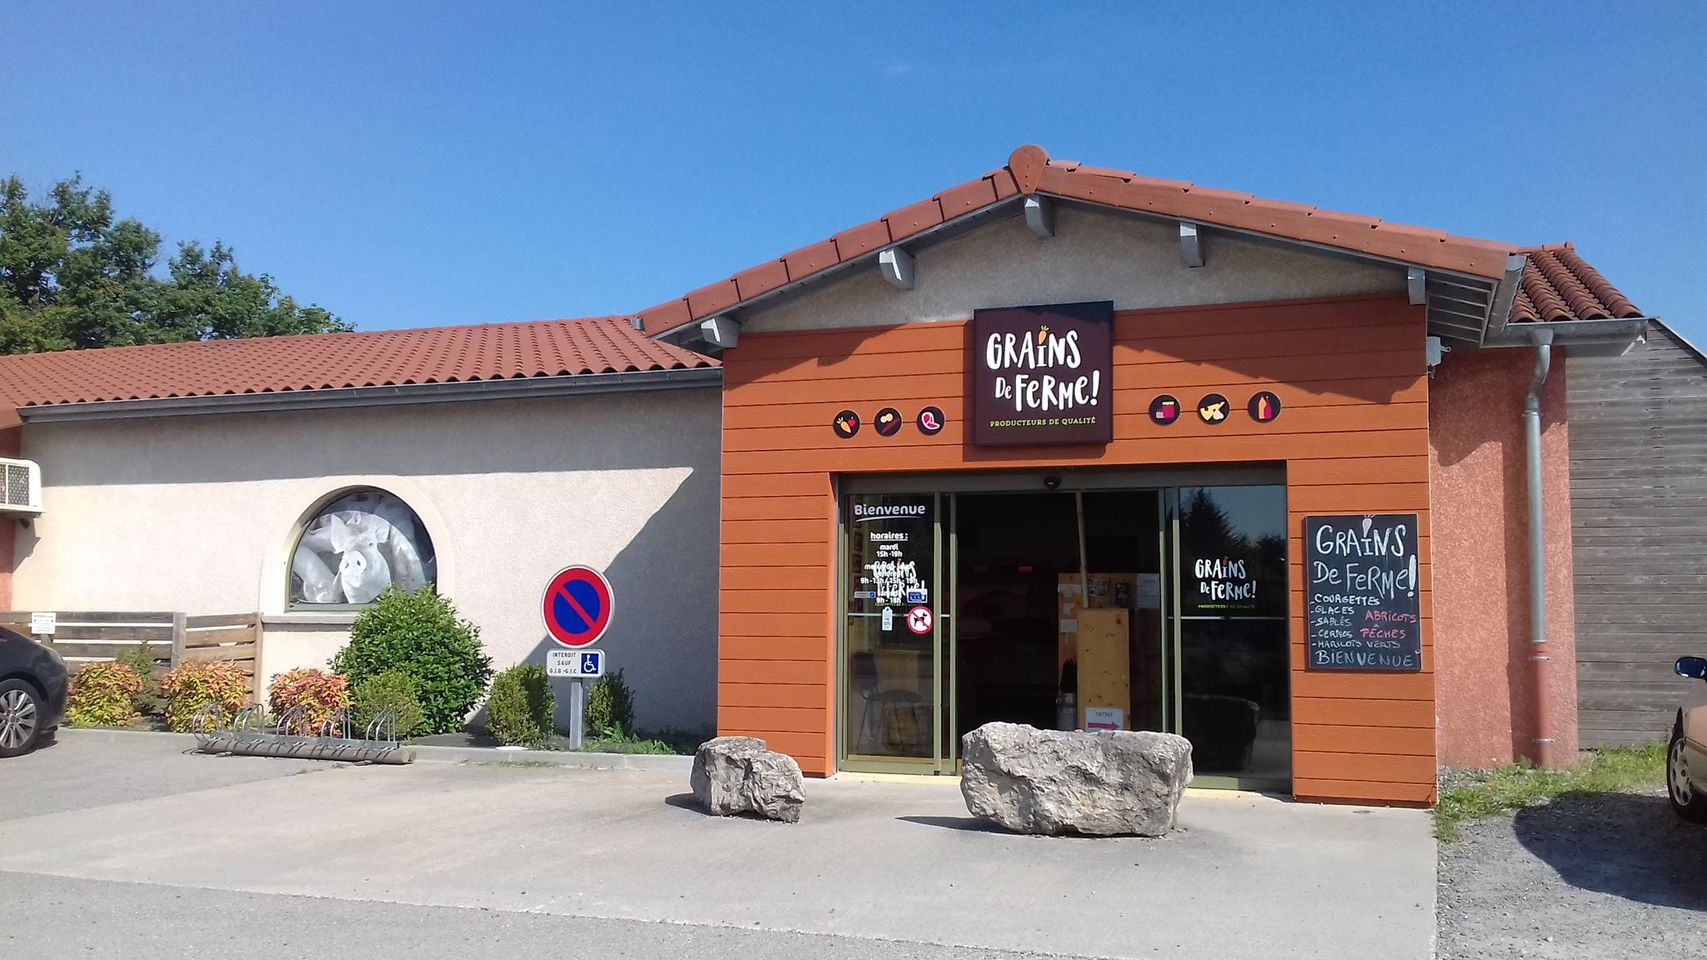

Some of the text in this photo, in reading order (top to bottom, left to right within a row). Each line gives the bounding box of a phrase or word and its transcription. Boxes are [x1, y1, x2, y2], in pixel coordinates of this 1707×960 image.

[990, 418, 1047, 427] PRODUCTEURS
[1061, 416, 1096, 426] QUALITÉ
[854, 504, 926, 516] Bienvenue
[870, 532, 904, 540] horaires
[880, 543, 899, 551] mardi
[876, 550, 888, 558] 15h
